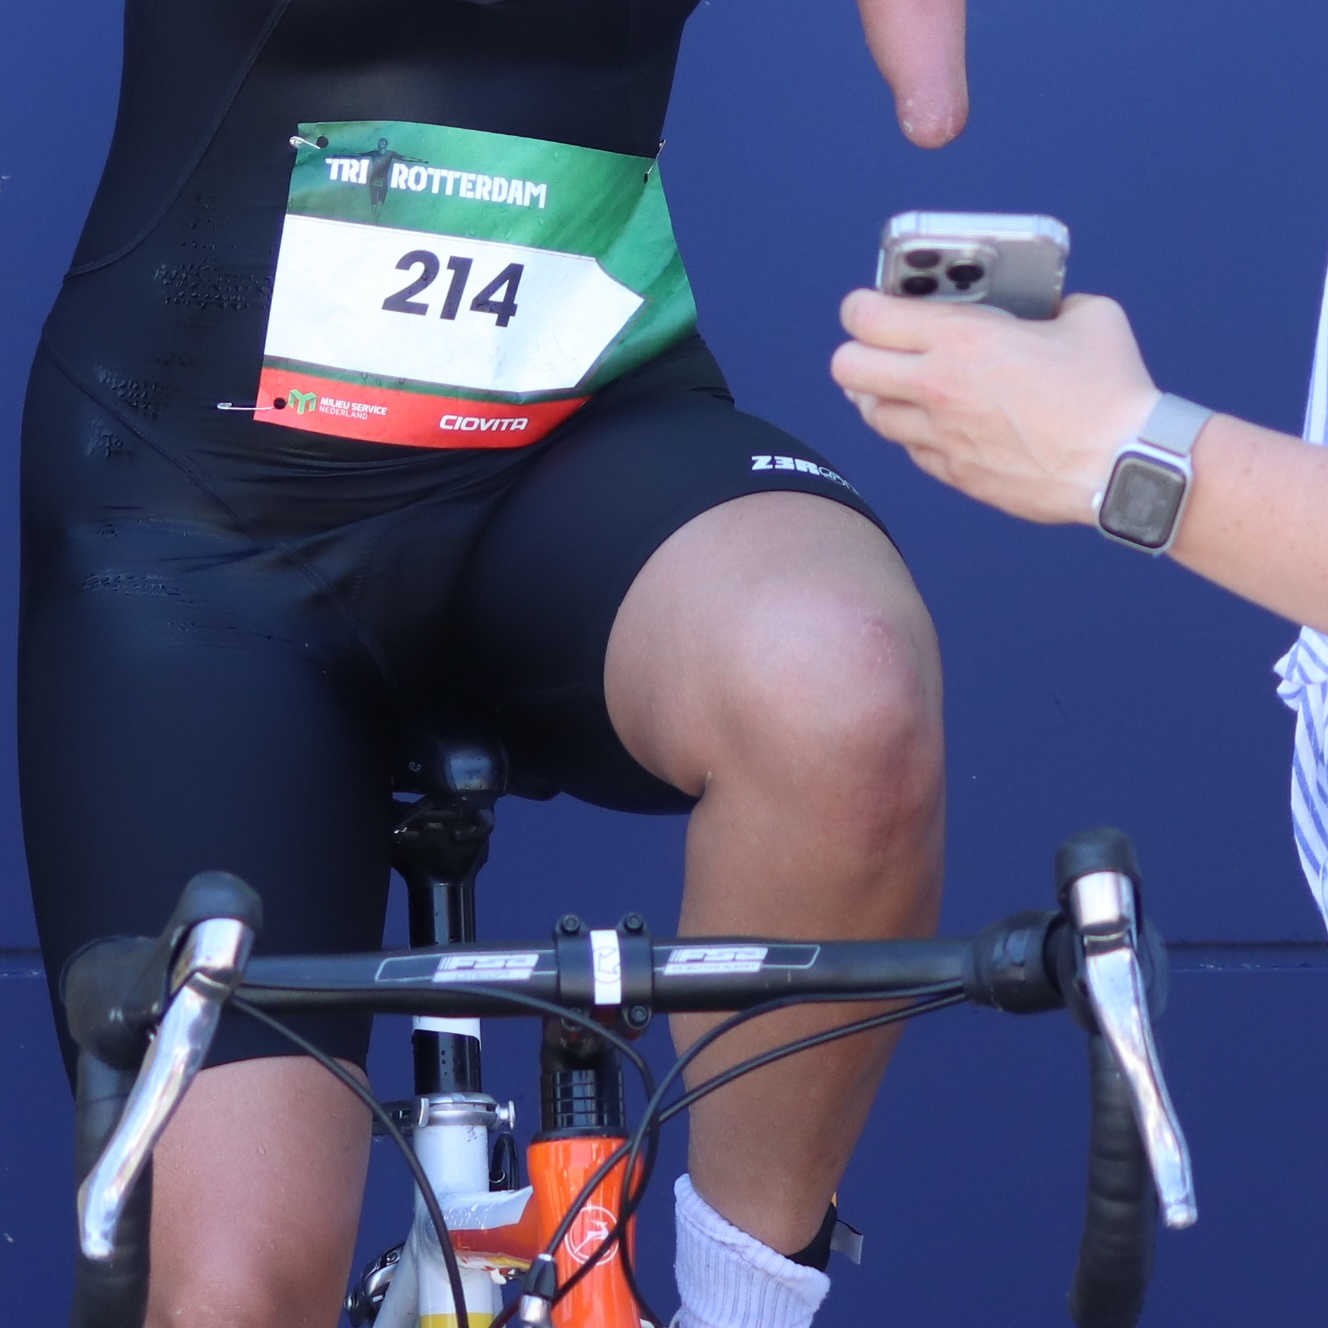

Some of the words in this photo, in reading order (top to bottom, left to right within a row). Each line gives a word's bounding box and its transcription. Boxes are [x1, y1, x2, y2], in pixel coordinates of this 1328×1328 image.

[325, 158, 370, 185] TRI
[390, 162, 548, 209] ROTTERDAM
[381, 249, 525, 328] 214
[318, 405, 369, 421] NEDERLAND
[320, 397, 351, 411] MILIEU
[351, 402, 388, 416] SERVICE
[439, 414, 529, 432] CIOVITA
